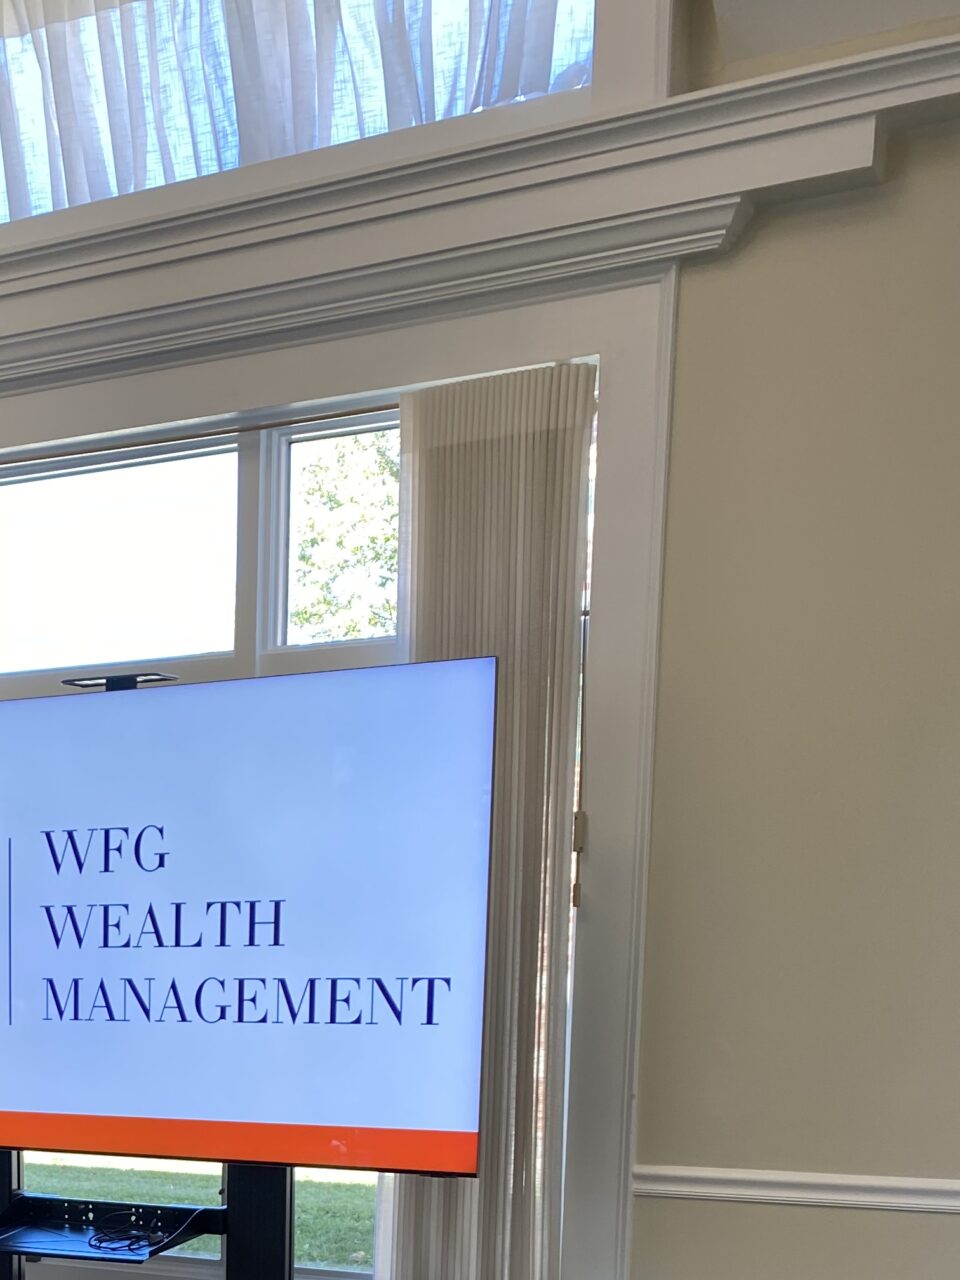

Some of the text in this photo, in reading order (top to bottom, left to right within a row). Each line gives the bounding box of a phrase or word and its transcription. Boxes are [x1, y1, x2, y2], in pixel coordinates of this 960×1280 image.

[40, 825, 170, 876] WFG
[40, 899, 287, 950] WEALTH
[42, 976, 452, 1027] MANAGEMENT
